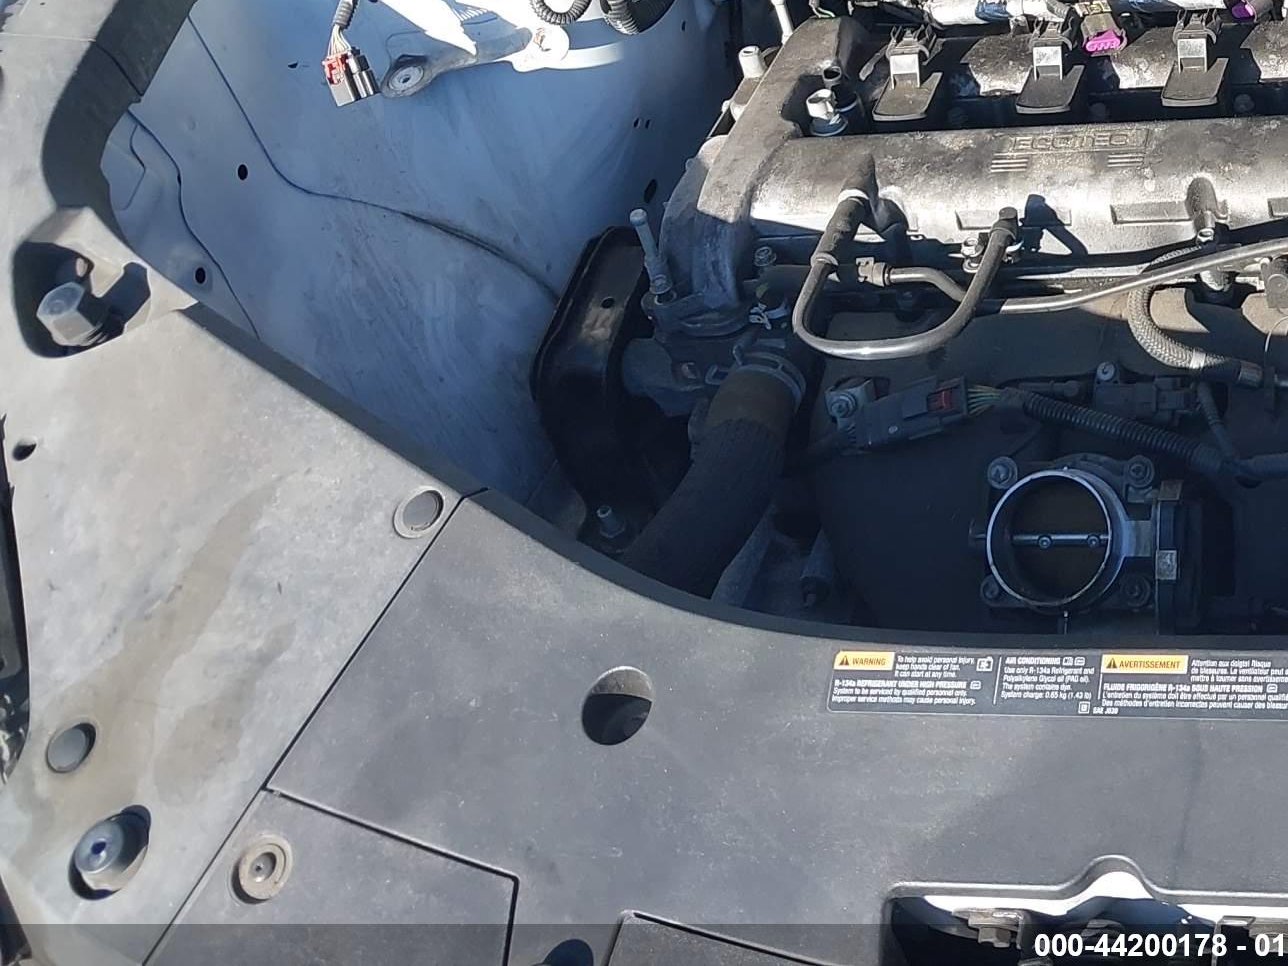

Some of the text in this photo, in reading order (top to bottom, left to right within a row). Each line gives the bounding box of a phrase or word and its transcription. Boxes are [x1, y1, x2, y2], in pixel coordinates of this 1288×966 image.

[1012, 132, 1128, 151] ECOTEC
[852, 658, 886, 666] WARNING
[897, 655, 904, 663] To
[905, 656, 917, 664] help
[933, 657, 958, 665] personal
[1017, 657, 1060, 665] CONDITIONING
[1119, 660, 1180, 669] AVERTISSEMENT
[1191, 659, 1217, 667] Attention
[1251, 659, 1272, 668] Risque
[1004, 666, 1015, 674] Use
[1016, 666, 1028, 675] only
[1051, 667, 1083, 675] Refrigerant
[1083, 667, 1095, 675] and
[1230, 667, 1238, 675] Le
[1270, 668, 1284, 676] peut
[1039, 675, 1056, 683] Glycol
[898, 680, 919, 688] UNDER
[919, 681, 935, 689] HIGH
[935, 681, 967, 689] PRESSURE
[1002, 682, 1013, 690] The
[1014, 683, 1034, 691] system
[1103, 683, 1125, 691] FLUIDE
[1167, 683, 1190, 693] R-134a
[1191, 684, 1209, 692] SOUS
[1209, 684, 1231, 692] HAUTE
[1231, 684, 1262, 693] PRESSION
[833, 687, 853, 695] System
[926, 689, 954, 697] personnel
[1001, 690, 1021, 699] System
[1045, 691, 1059, 699] 0.65
[1059, 691, 1067, 700] kg
[832, 695, 857, 703] Improper
[933, 697, 958, 705] personal
[1142, 692, 1166, 700] système
[1167, 692, 1179, 700] doit
[1237, 693, 1266, 702] personnel
[1113, 699, 1142, 707] méthodes
[1175, 700, 1208, 708] incorrectes
[1254, 701, 1265, 709] des
